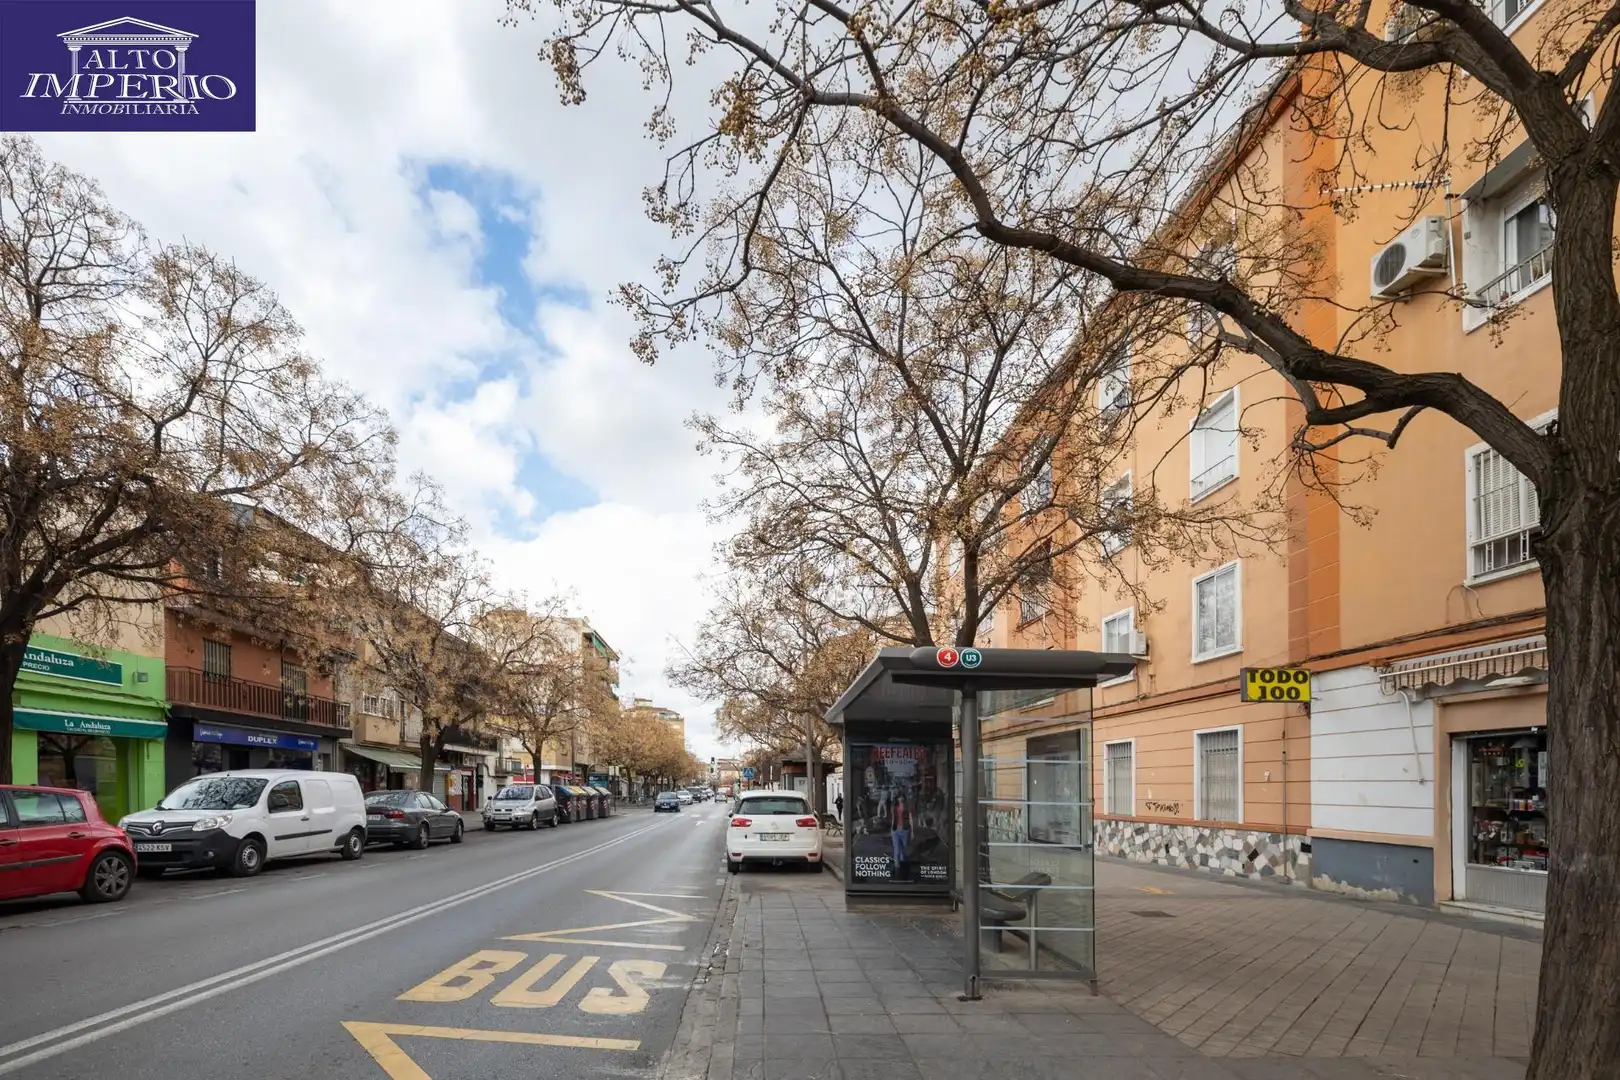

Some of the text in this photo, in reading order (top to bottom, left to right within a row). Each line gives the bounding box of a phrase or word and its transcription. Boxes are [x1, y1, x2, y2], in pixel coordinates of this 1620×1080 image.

[944, 652, 952, 662] 4
[965, 654, 977, 662] U3
[22, 661, 50, 671] PRECIO
[1247, 669, 1309, 684] TODO
[1257, 685, 1301, 700] 100
[80, 720, 112, 730] Andaluza
[247, 735, 278, 745] DUPLEX
[855, 856, 890, 864] CLASSICS
[855, 863, 887, 871] FOLLOW
[855, 870, 891, 878] NOTHING
[396, 949, 667, 1015] BUS
